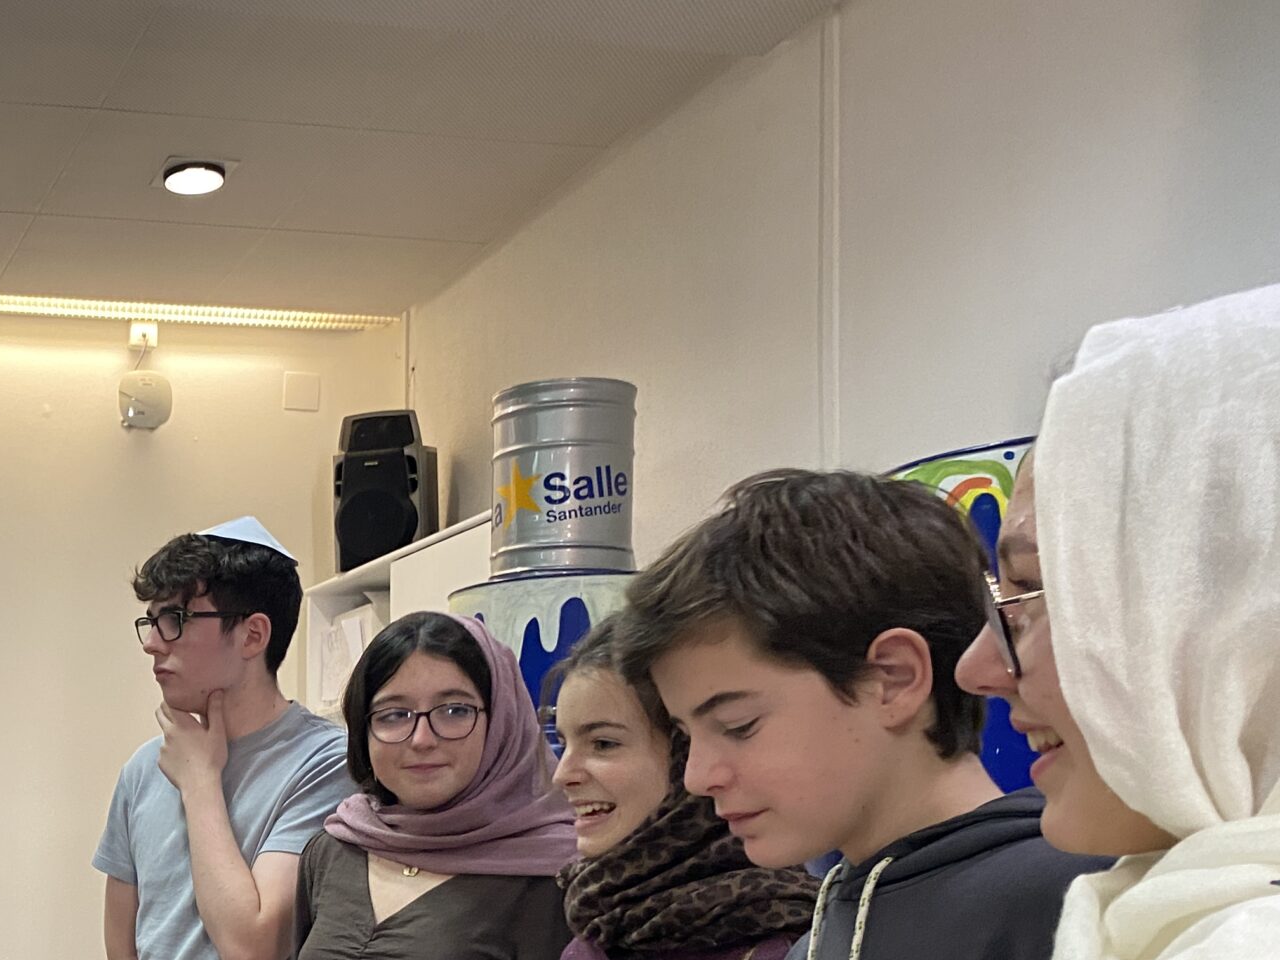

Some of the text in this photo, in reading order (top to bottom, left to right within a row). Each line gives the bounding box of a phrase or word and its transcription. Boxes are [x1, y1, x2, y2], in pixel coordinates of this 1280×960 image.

[493, 465, 628, 528] a Salle
[546, 501, 622, 523] Santander
